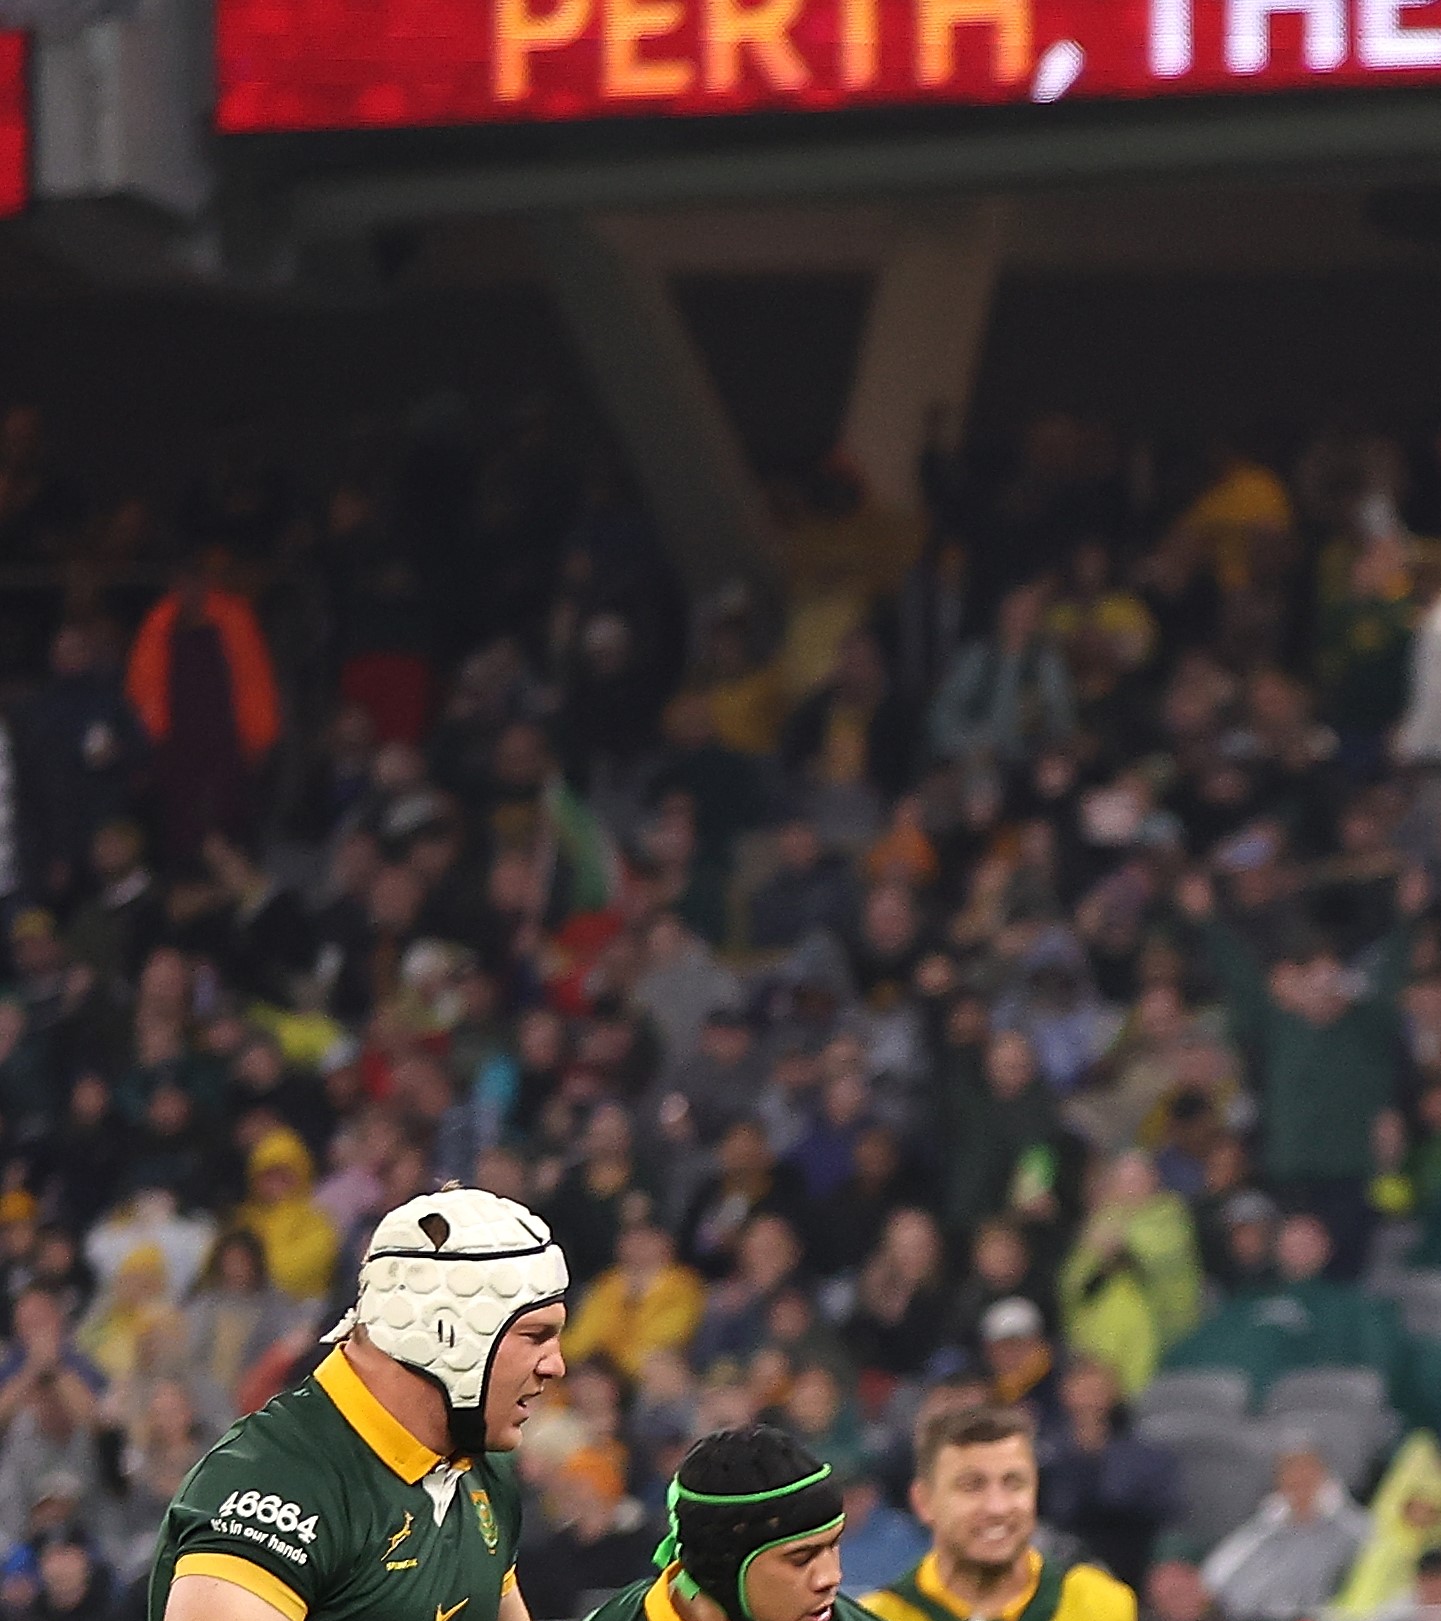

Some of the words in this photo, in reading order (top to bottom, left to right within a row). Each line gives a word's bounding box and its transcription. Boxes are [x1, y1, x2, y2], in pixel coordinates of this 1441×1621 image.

[218, 1490, 320, 1545] 46664
[229, 1519, 243, 1535] in
[243, 1527, 269, 1543] our
[267, 1533, 308, 1565] hands
